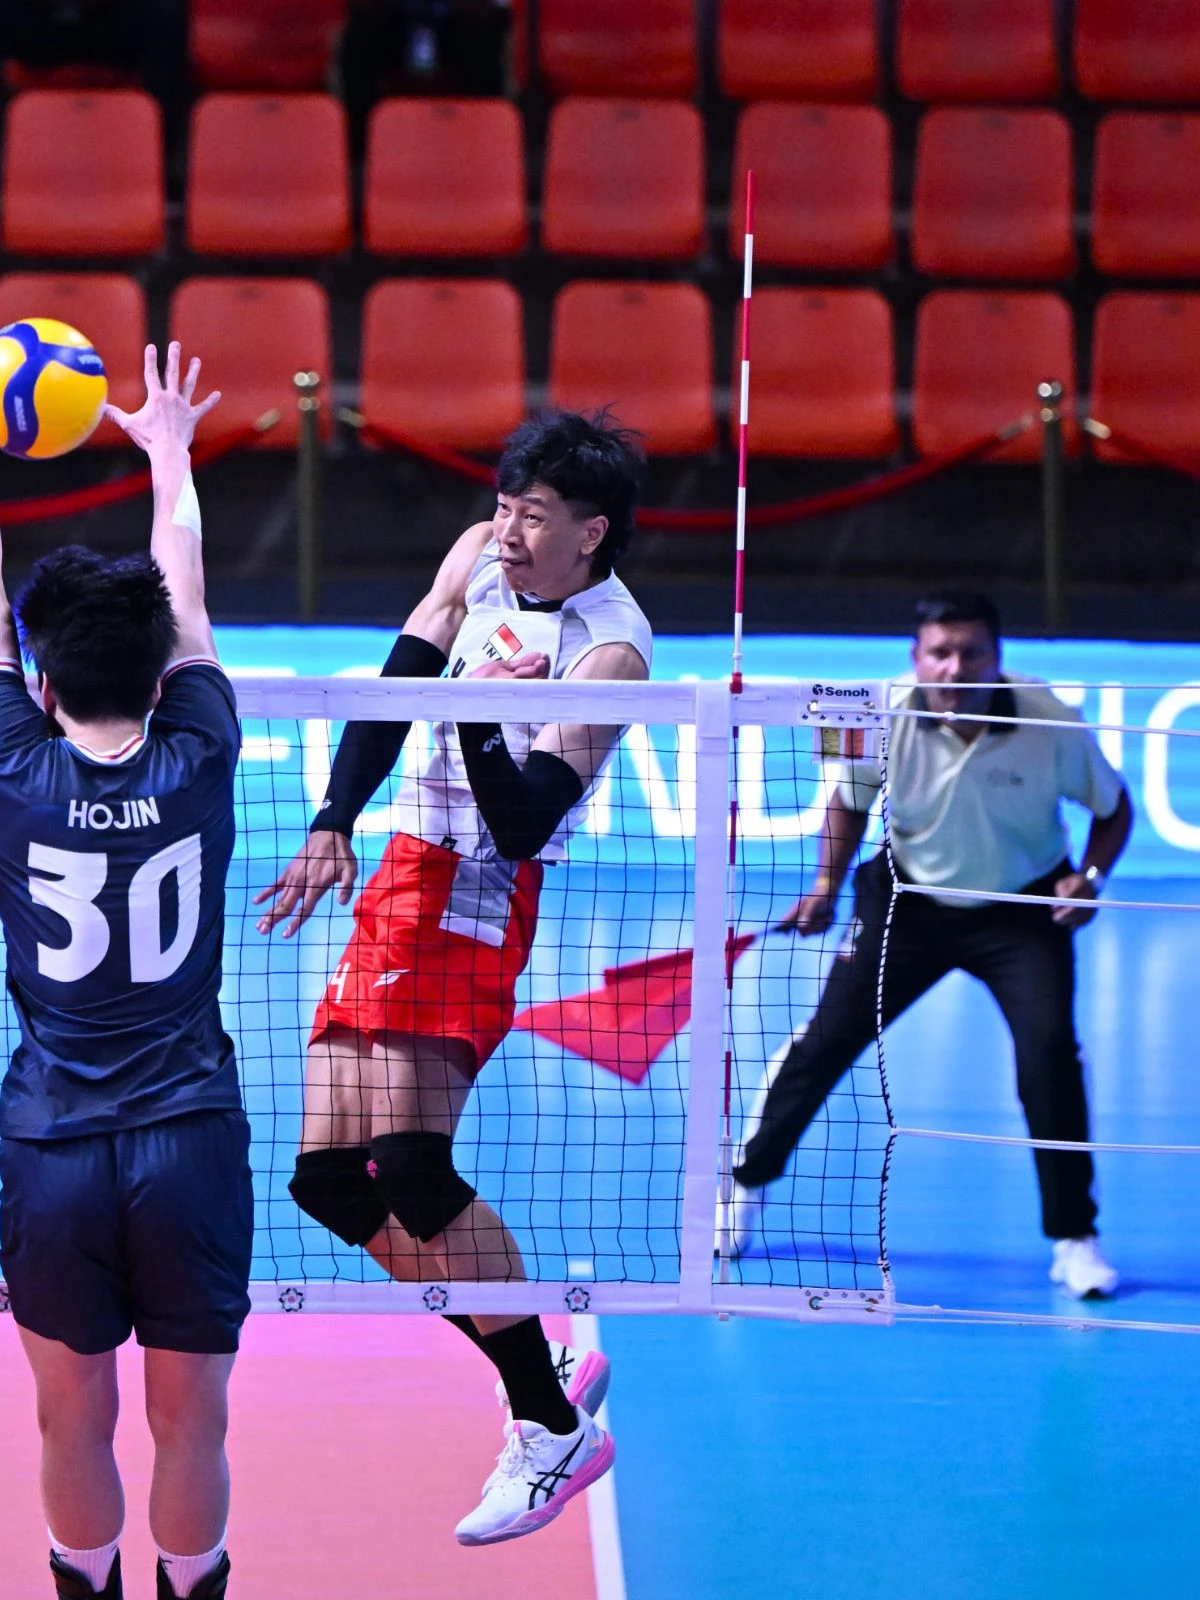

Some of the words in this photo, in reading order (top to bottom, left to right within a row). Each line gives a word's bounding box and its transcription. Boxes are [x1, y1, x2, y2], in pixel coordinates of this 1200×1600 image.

[482, 642, 503, 661] IN
[825, 687, 869, 697] Senoh
[68, 796, 161, 829] HOJIN
[28, 832, 202, 982] 30
[329, 962, 350, 1004] 4
